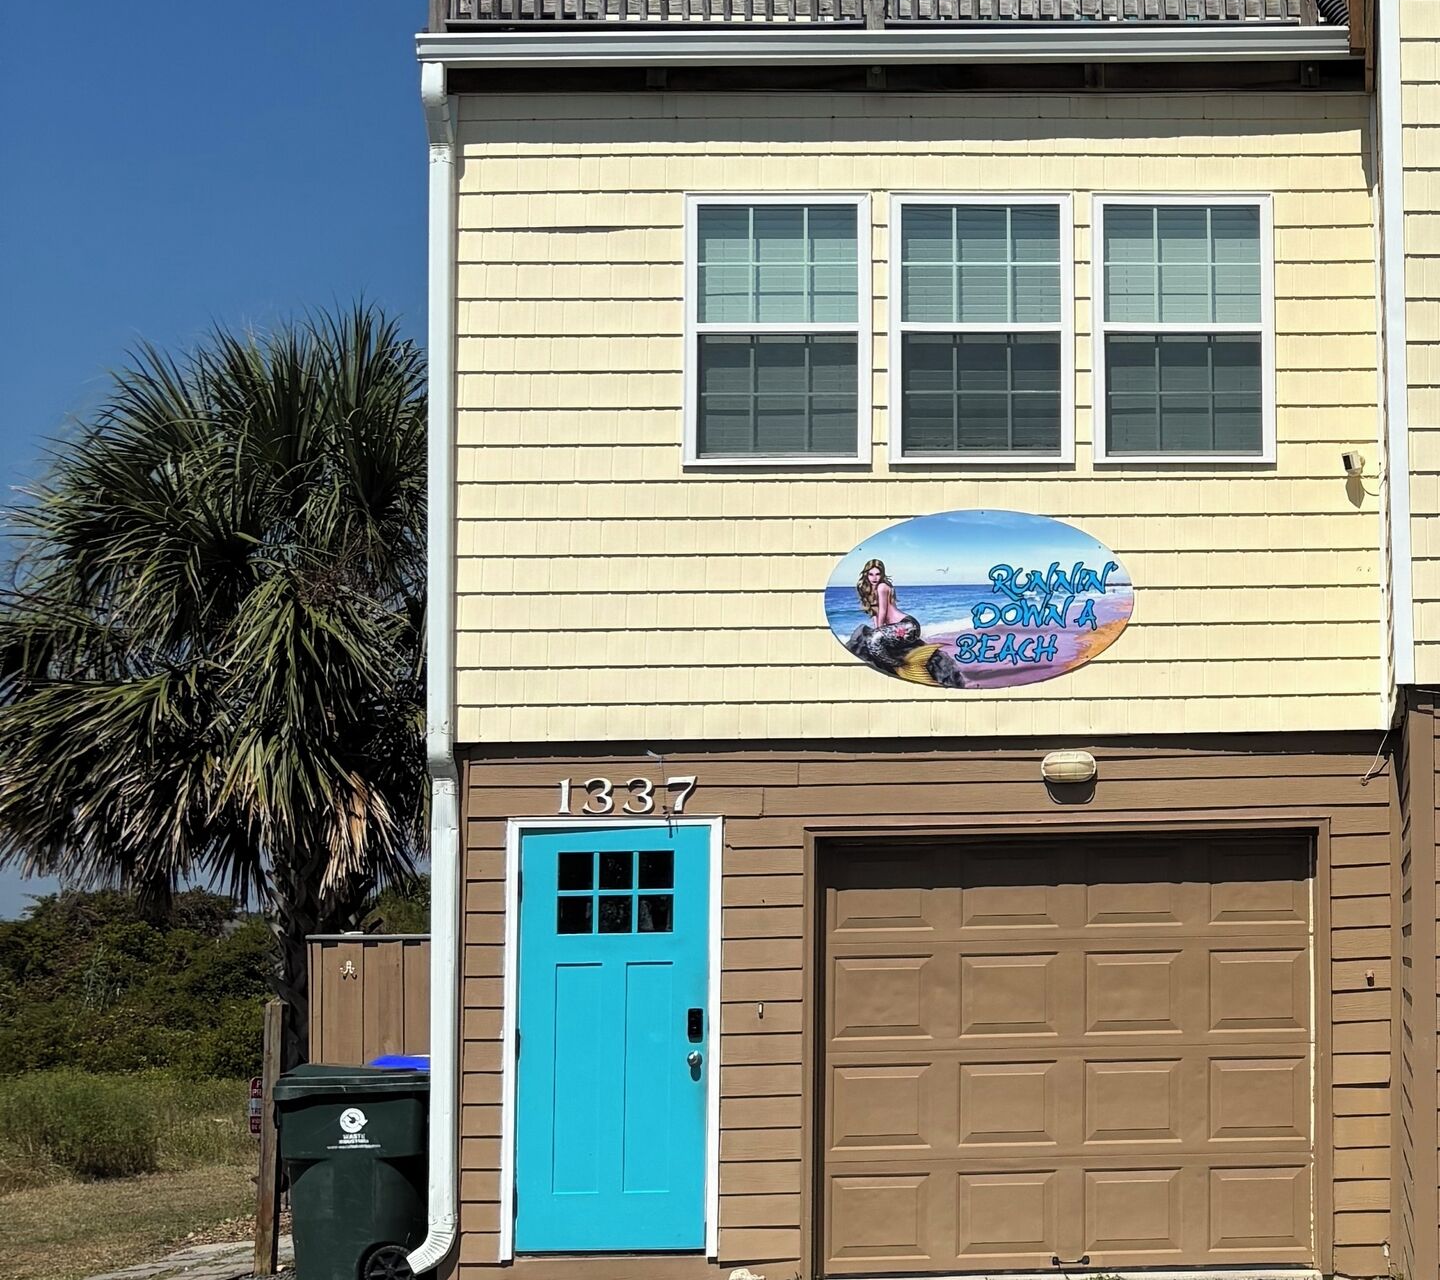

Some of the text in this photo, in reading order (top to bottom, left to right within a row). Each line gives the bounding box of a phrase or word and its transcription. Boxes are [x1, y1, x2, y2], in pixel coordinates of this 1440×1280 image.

[988, 561, 1119, 602] RUNNIN'
[970, 594, 1098, 631] DOWN A
[954, 633, 1058, 666] BEACH
[557, 775, 699, 815] 1337
